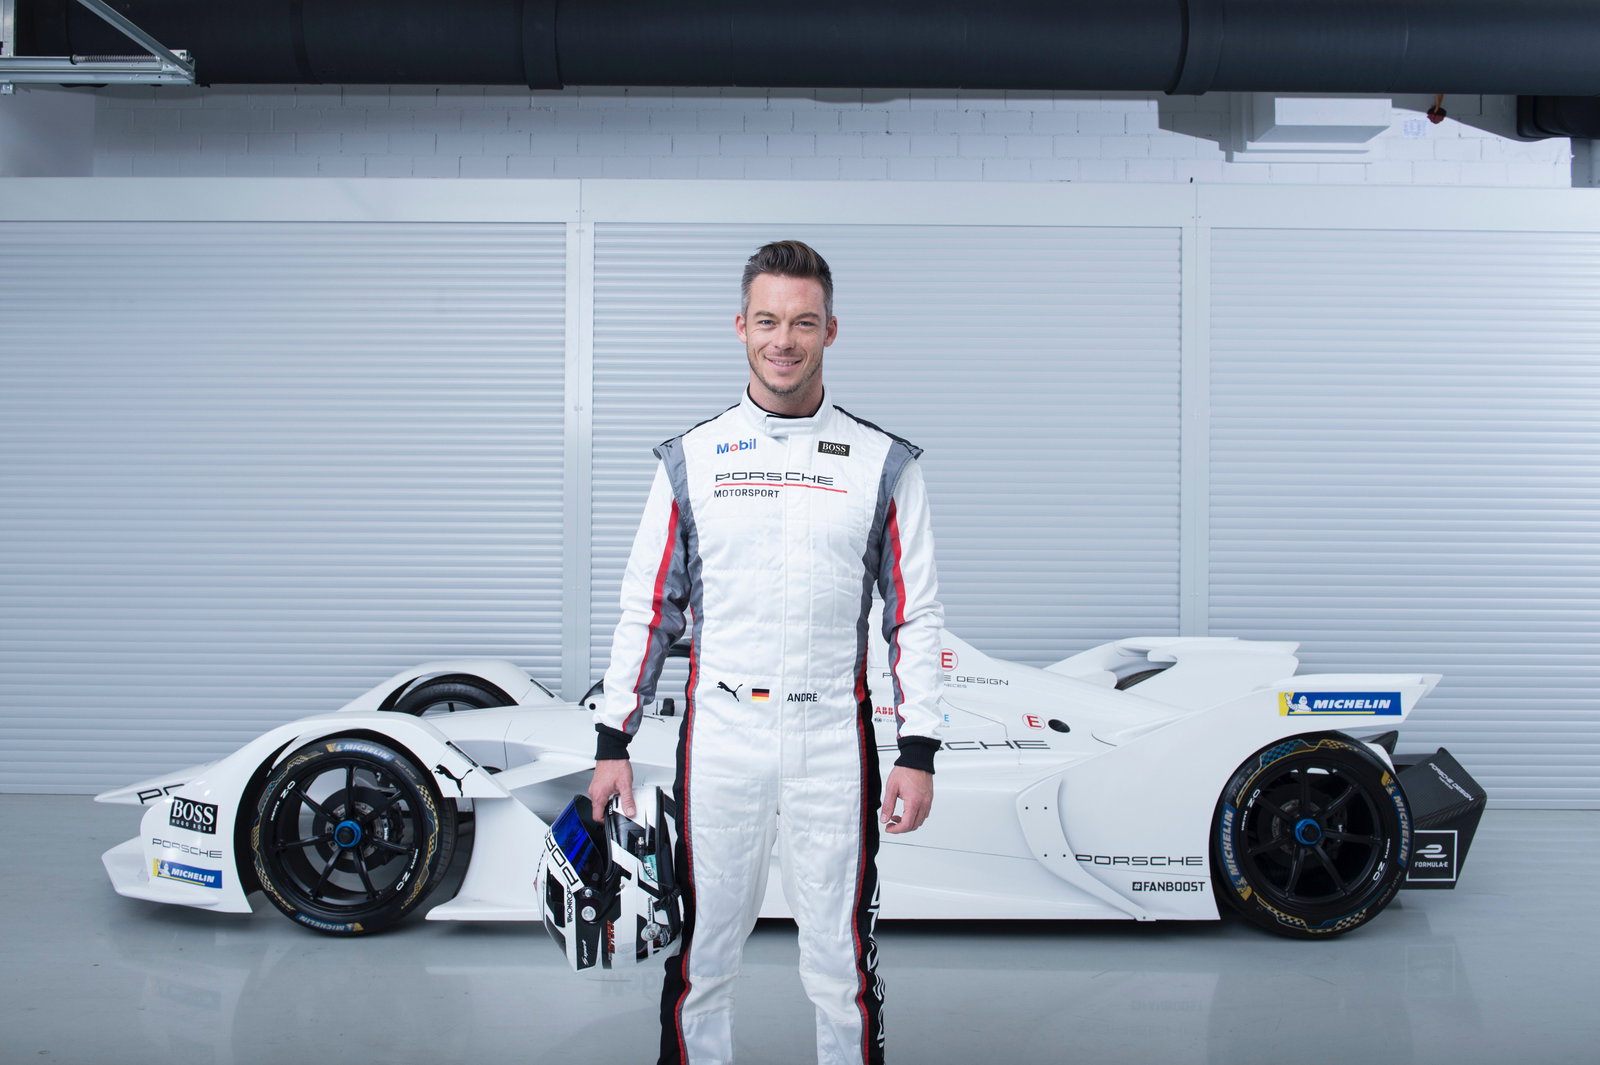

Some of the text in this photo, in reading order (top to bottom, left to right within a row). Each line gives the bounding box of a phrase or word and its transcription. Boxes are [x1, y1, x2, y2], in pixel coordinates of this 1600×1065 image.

[716, 438, 756, 454] Mobil
[822, 442, 847, 453] BOSS
[715, 472, 834, 486] PORSCHE
[713, 488, 780, 499] MOTORSPORT
[956, 675, 1009, 686] DESIGN
[874, 706, 893, 715] ABB
[1313, 699, 1392, 709] MICHELIN
[344, 744, 391, 760] MICHELIN
[171, 799, 214, 825] BOSS
[1393, 795, 1410, 861] MICHELIN
[152, 838, 223, 859] PORSCHE
[1222, 809, 1240, 876] MICHELIN
[1075, 854, 1204, 866] PORSCHE
[171, 868, 216, 884] MICHELIN
[299, 915, 345, 931] MICHELIN
